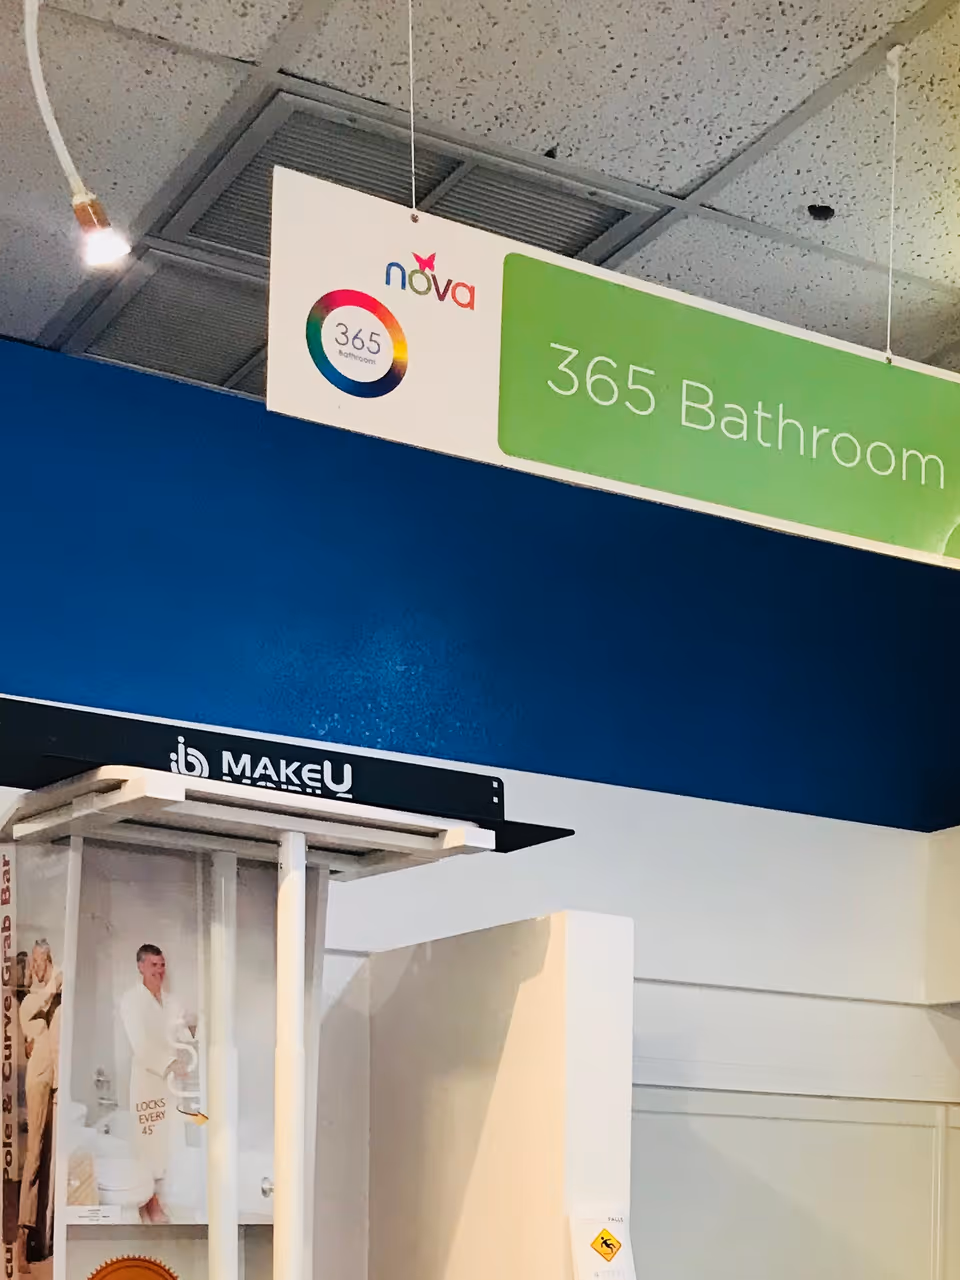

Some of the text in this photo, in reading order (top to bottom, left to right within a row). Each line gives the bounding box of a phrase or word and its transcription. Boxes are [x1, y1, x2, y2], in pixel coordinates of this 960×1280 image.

[385, 261, 475, 311] nova
[334, 322, 381, 355] 365
[338, 349, 376, 366] Bathroom
[546, 342, 946, 490] 365 Bathroom
[1, 854, 11, 906] Bar
[1, 915, 11, 988] Grab
[2, 995, 12, 1083] Curve
[136, 1098, 166, 1112] LOCKS
[139, 1110, 166, 1124] EVERY
